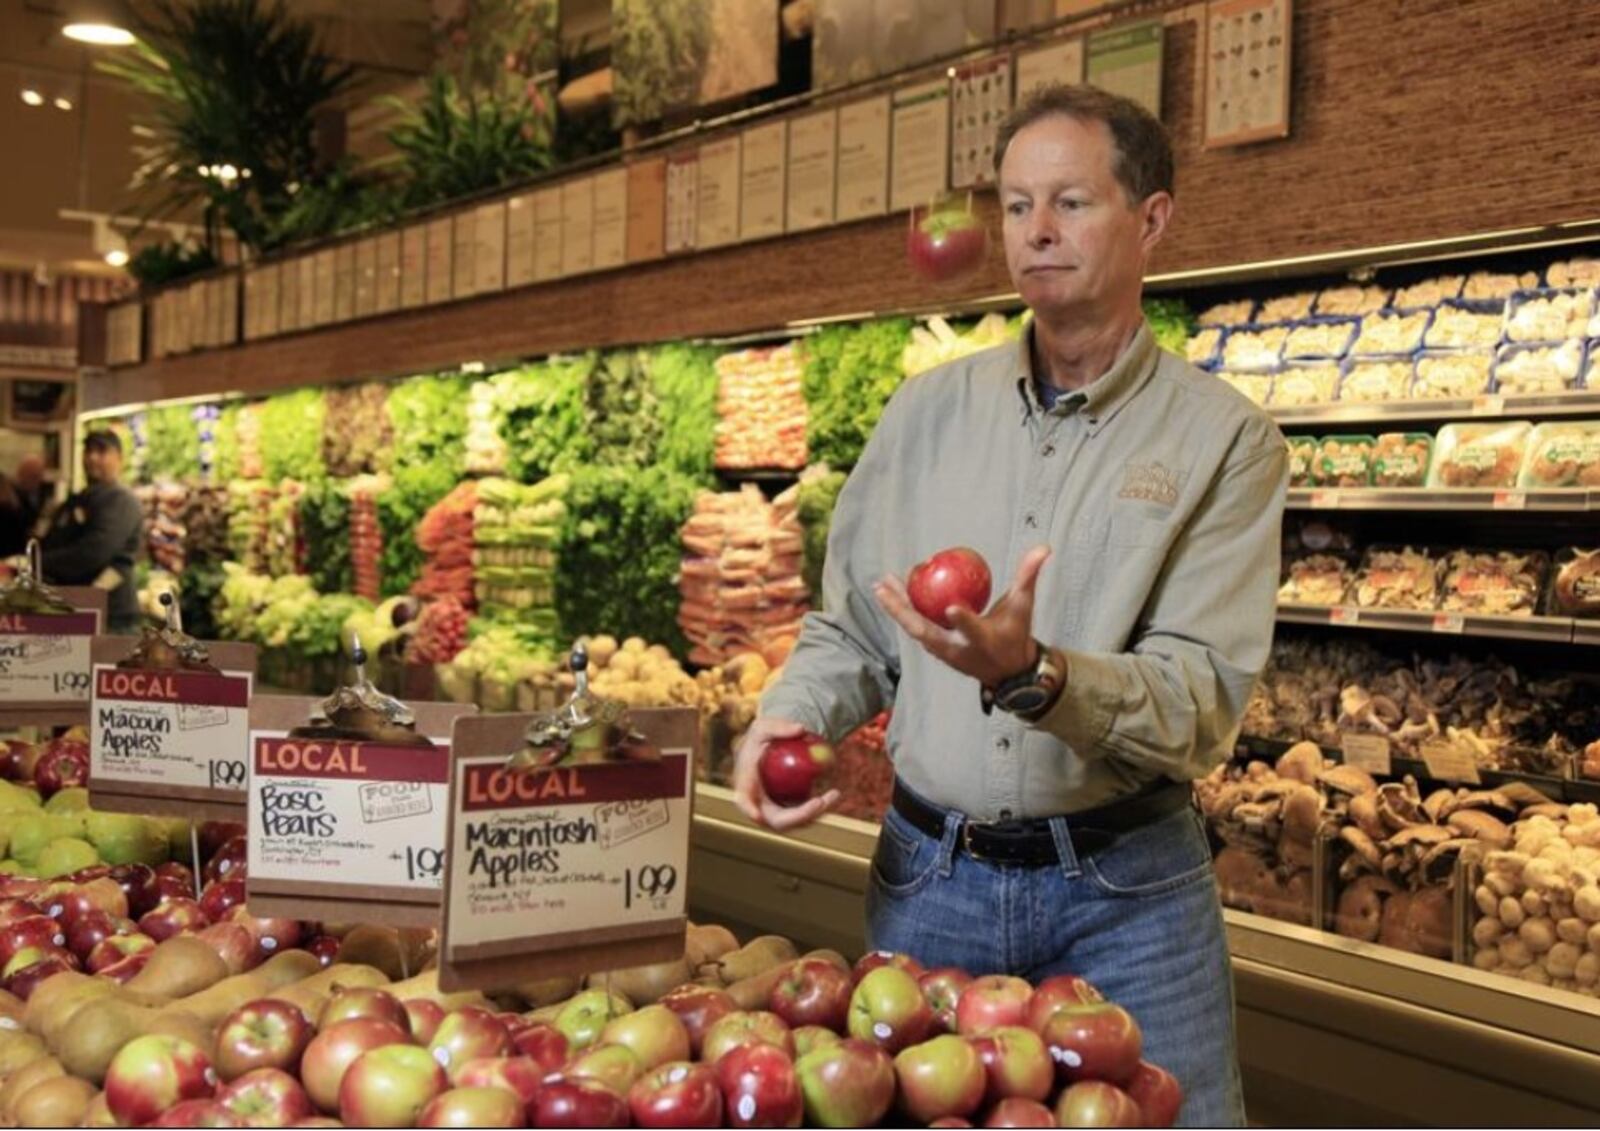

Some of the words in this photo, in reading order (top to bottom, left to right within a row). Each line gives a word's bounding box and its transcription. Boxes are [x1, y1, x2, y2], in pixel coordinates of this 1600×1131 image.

[54, 671, 91, 694] 1.99
[101, 674, 178, 698] LOCAL
[100, 708, 170, 734] Macoun
[101, 729, 162, 758] Apples
[260, 743, 367, 773] LOCAL
[209, 759, 246, 788] 1.99
[469, 769, 586, 803] LOCAL
[260, 785, 325, 813] Bosc
[261, 811, 337, 838] Pears
[466, 818, 597, 850] Macintosh
[468, 847, 560, 888] Apples
[624, 864, 677, 909] 1.99
